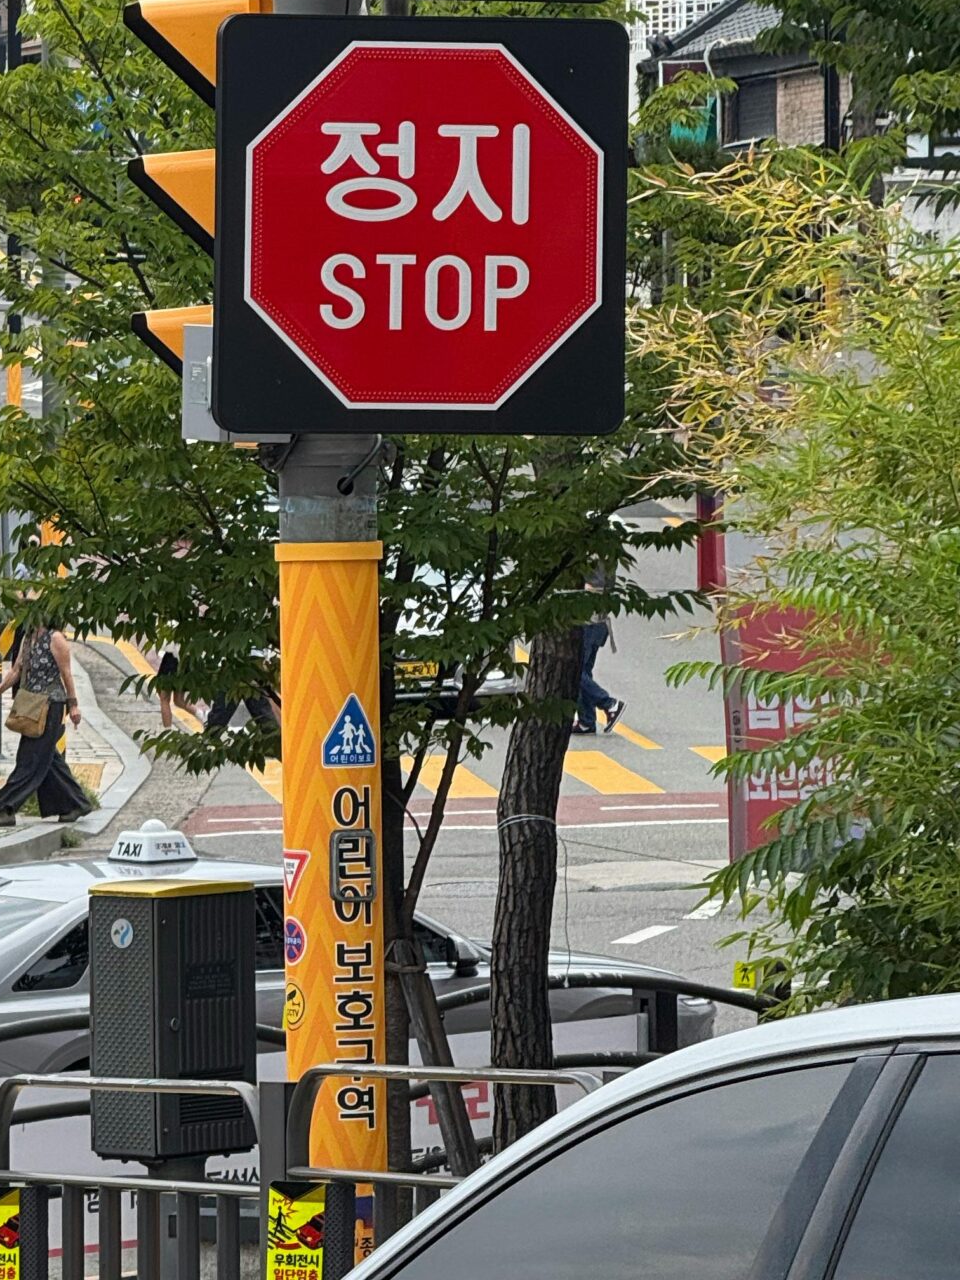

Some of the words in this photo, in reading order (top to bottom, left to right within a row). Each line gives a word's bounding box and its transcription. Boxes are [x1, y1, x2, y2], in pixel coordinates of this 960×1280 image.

[320, 120, 530, 225] 정지
[319, 253, 530, 331] STOP
[330, 754, 371, 763] 어린이보호
[118, 842, 142, 857] TAXI
[332, 785, 372, 926] 어린이
[333, 941, 376, 1130] 보호구역
[274, 1254, 319, 1268] 우회전시
